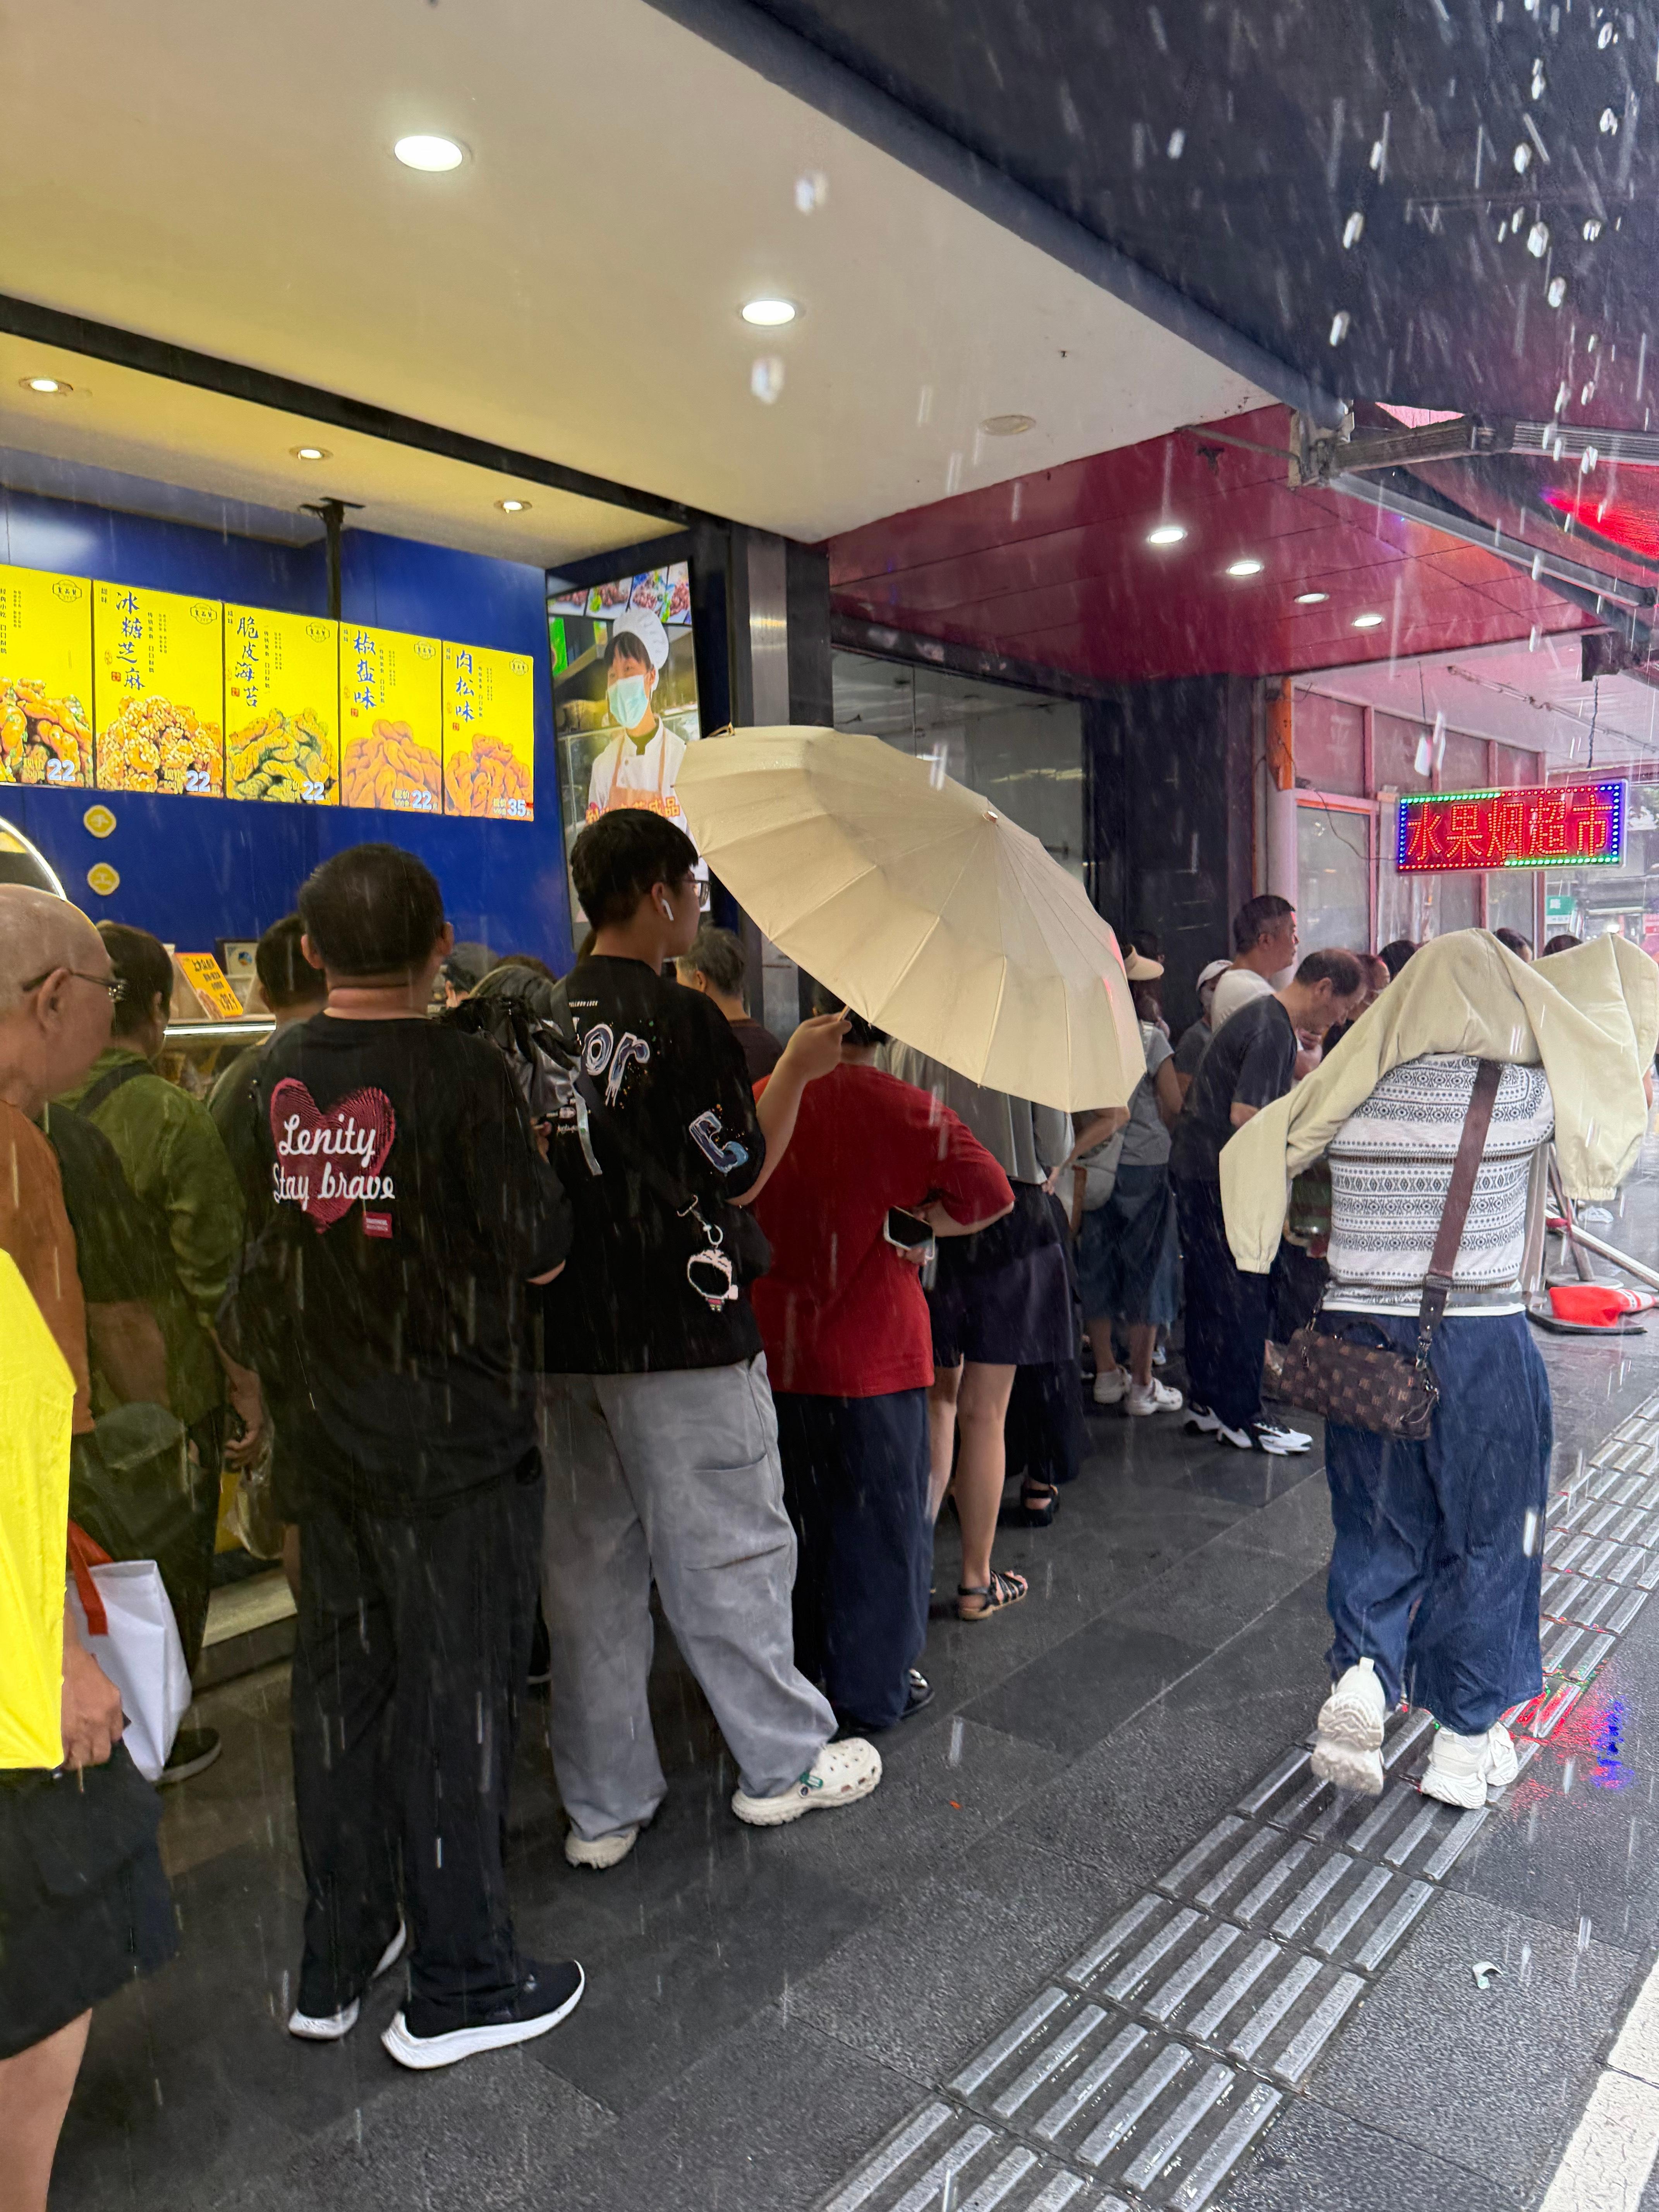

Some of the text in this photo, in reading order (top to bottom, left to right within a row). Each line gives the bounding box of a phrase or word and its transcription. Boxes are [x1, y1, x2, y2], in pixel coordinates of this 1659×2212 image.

[116, 591, 145, 690] 冰糖芝麻
[235, 616, 259, 707] 脆皮海苔
[353, 630, 377, 710] 椒盐味
[456, 649, 475, 723] 肉松味
[47, 758, 76, 781] 22
[186, 770, 210, 792] 22
[302, 780, 324, 800] 22
[412, 790, 432, 810] 22
[508, 799, 526, 817] 35
[1408, 793, 1613, 861] 水果烟超市
[279, 1114, 376, 1168] Lenity
[273, 1162, 395, 1211] Stay brave
